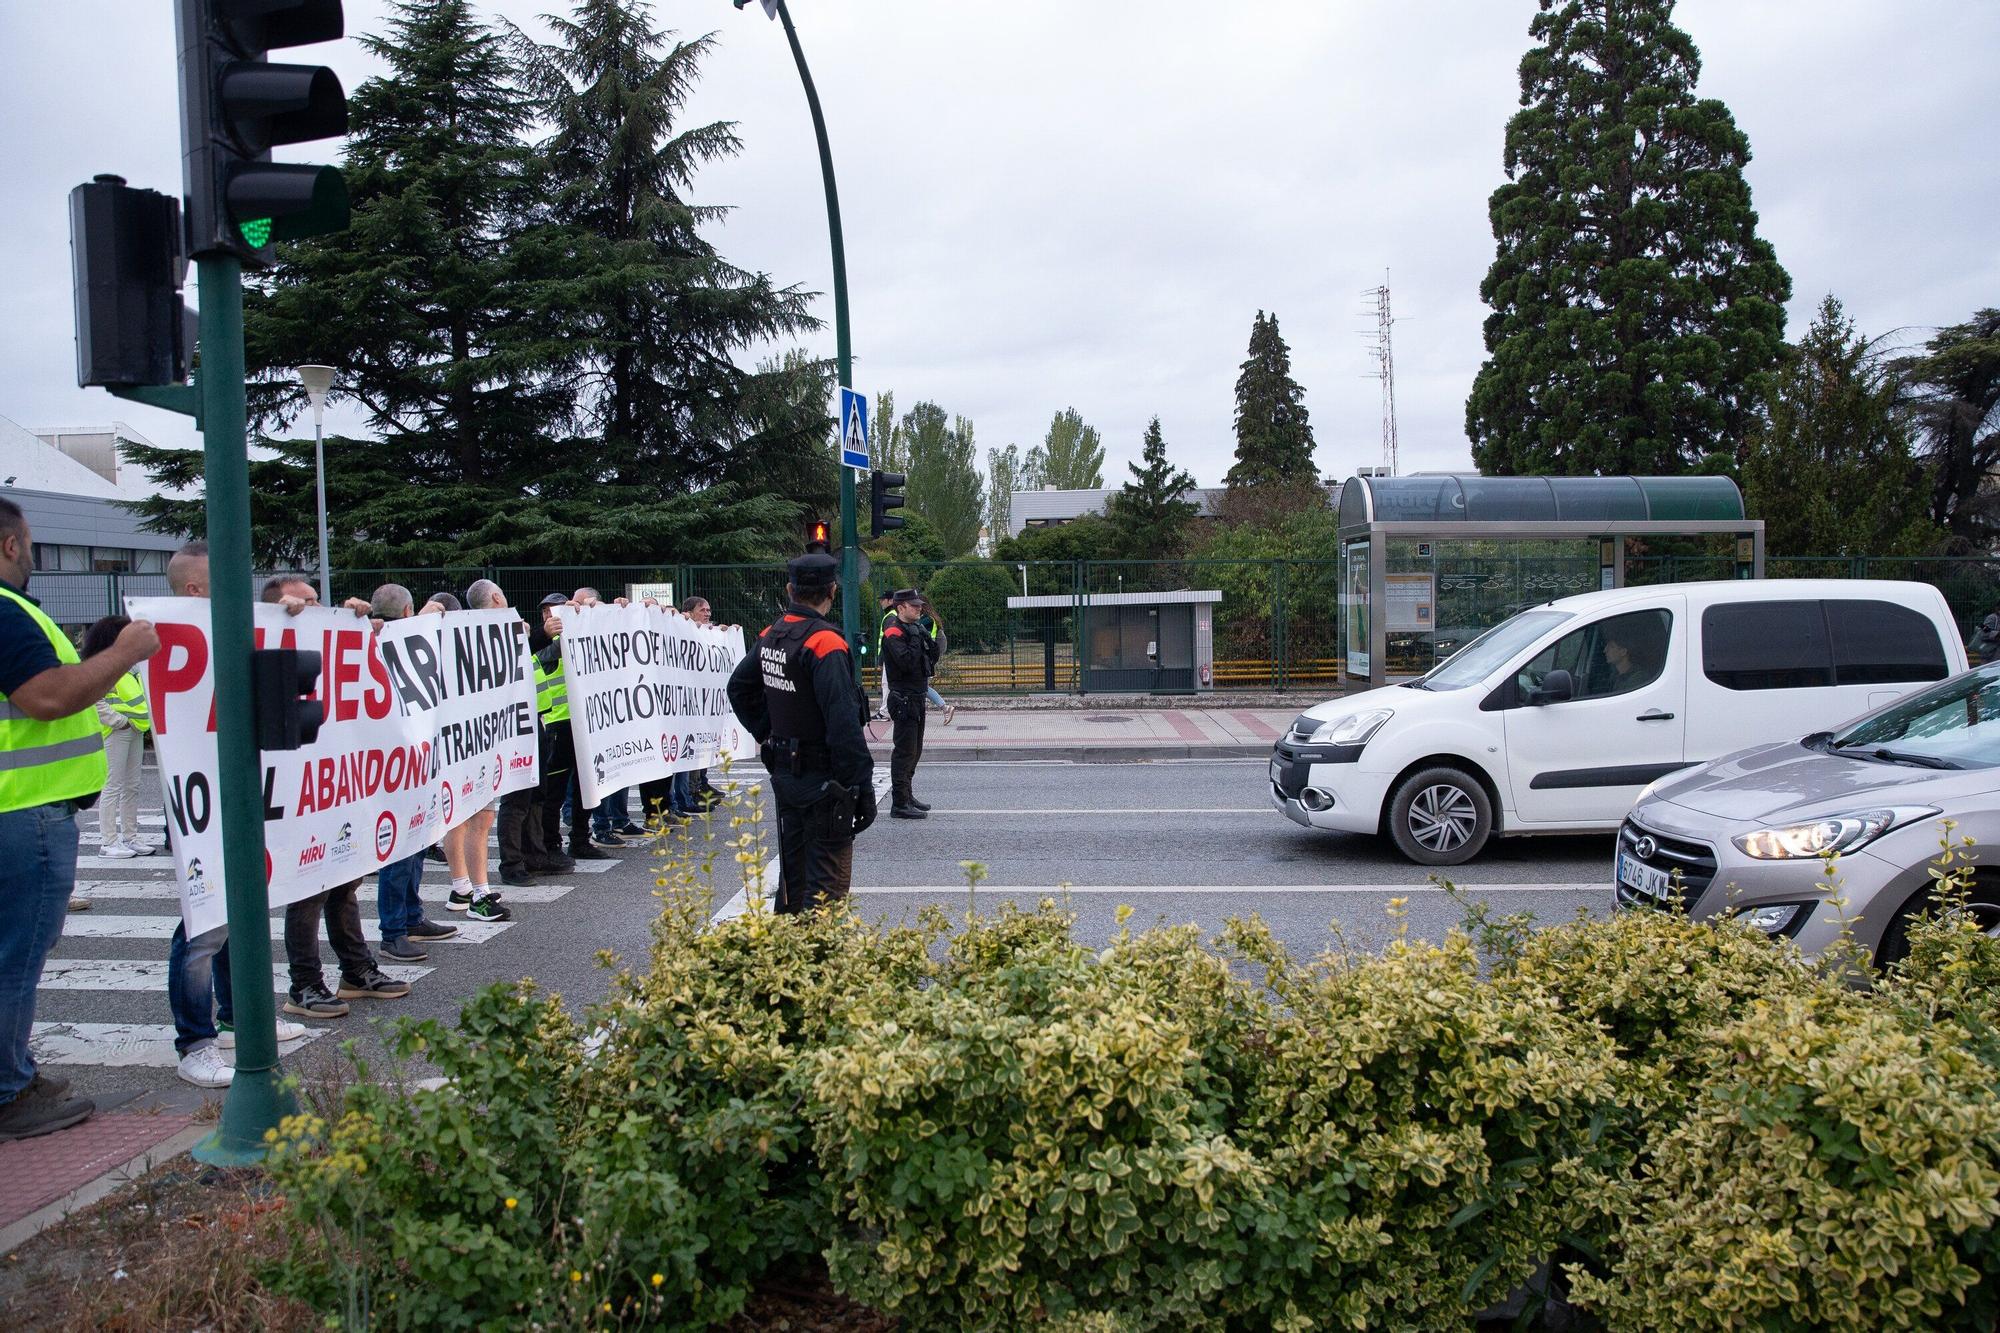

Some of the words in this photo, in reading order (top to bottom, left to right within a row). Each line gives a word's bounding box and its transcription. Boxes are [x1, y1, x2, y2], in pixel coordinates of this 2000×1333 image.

[453, 621, 525, 697] NADIE
[760, 646, 787, 664] POLICÍA
[761, 660, 785, 677] FORAL
[167, 771, 211, 837] NO
[296, 741, 431, 817] ABANDONO
[298, 842, 327, 866] HIRU
[1623, 860, 1644, 887] 6746
